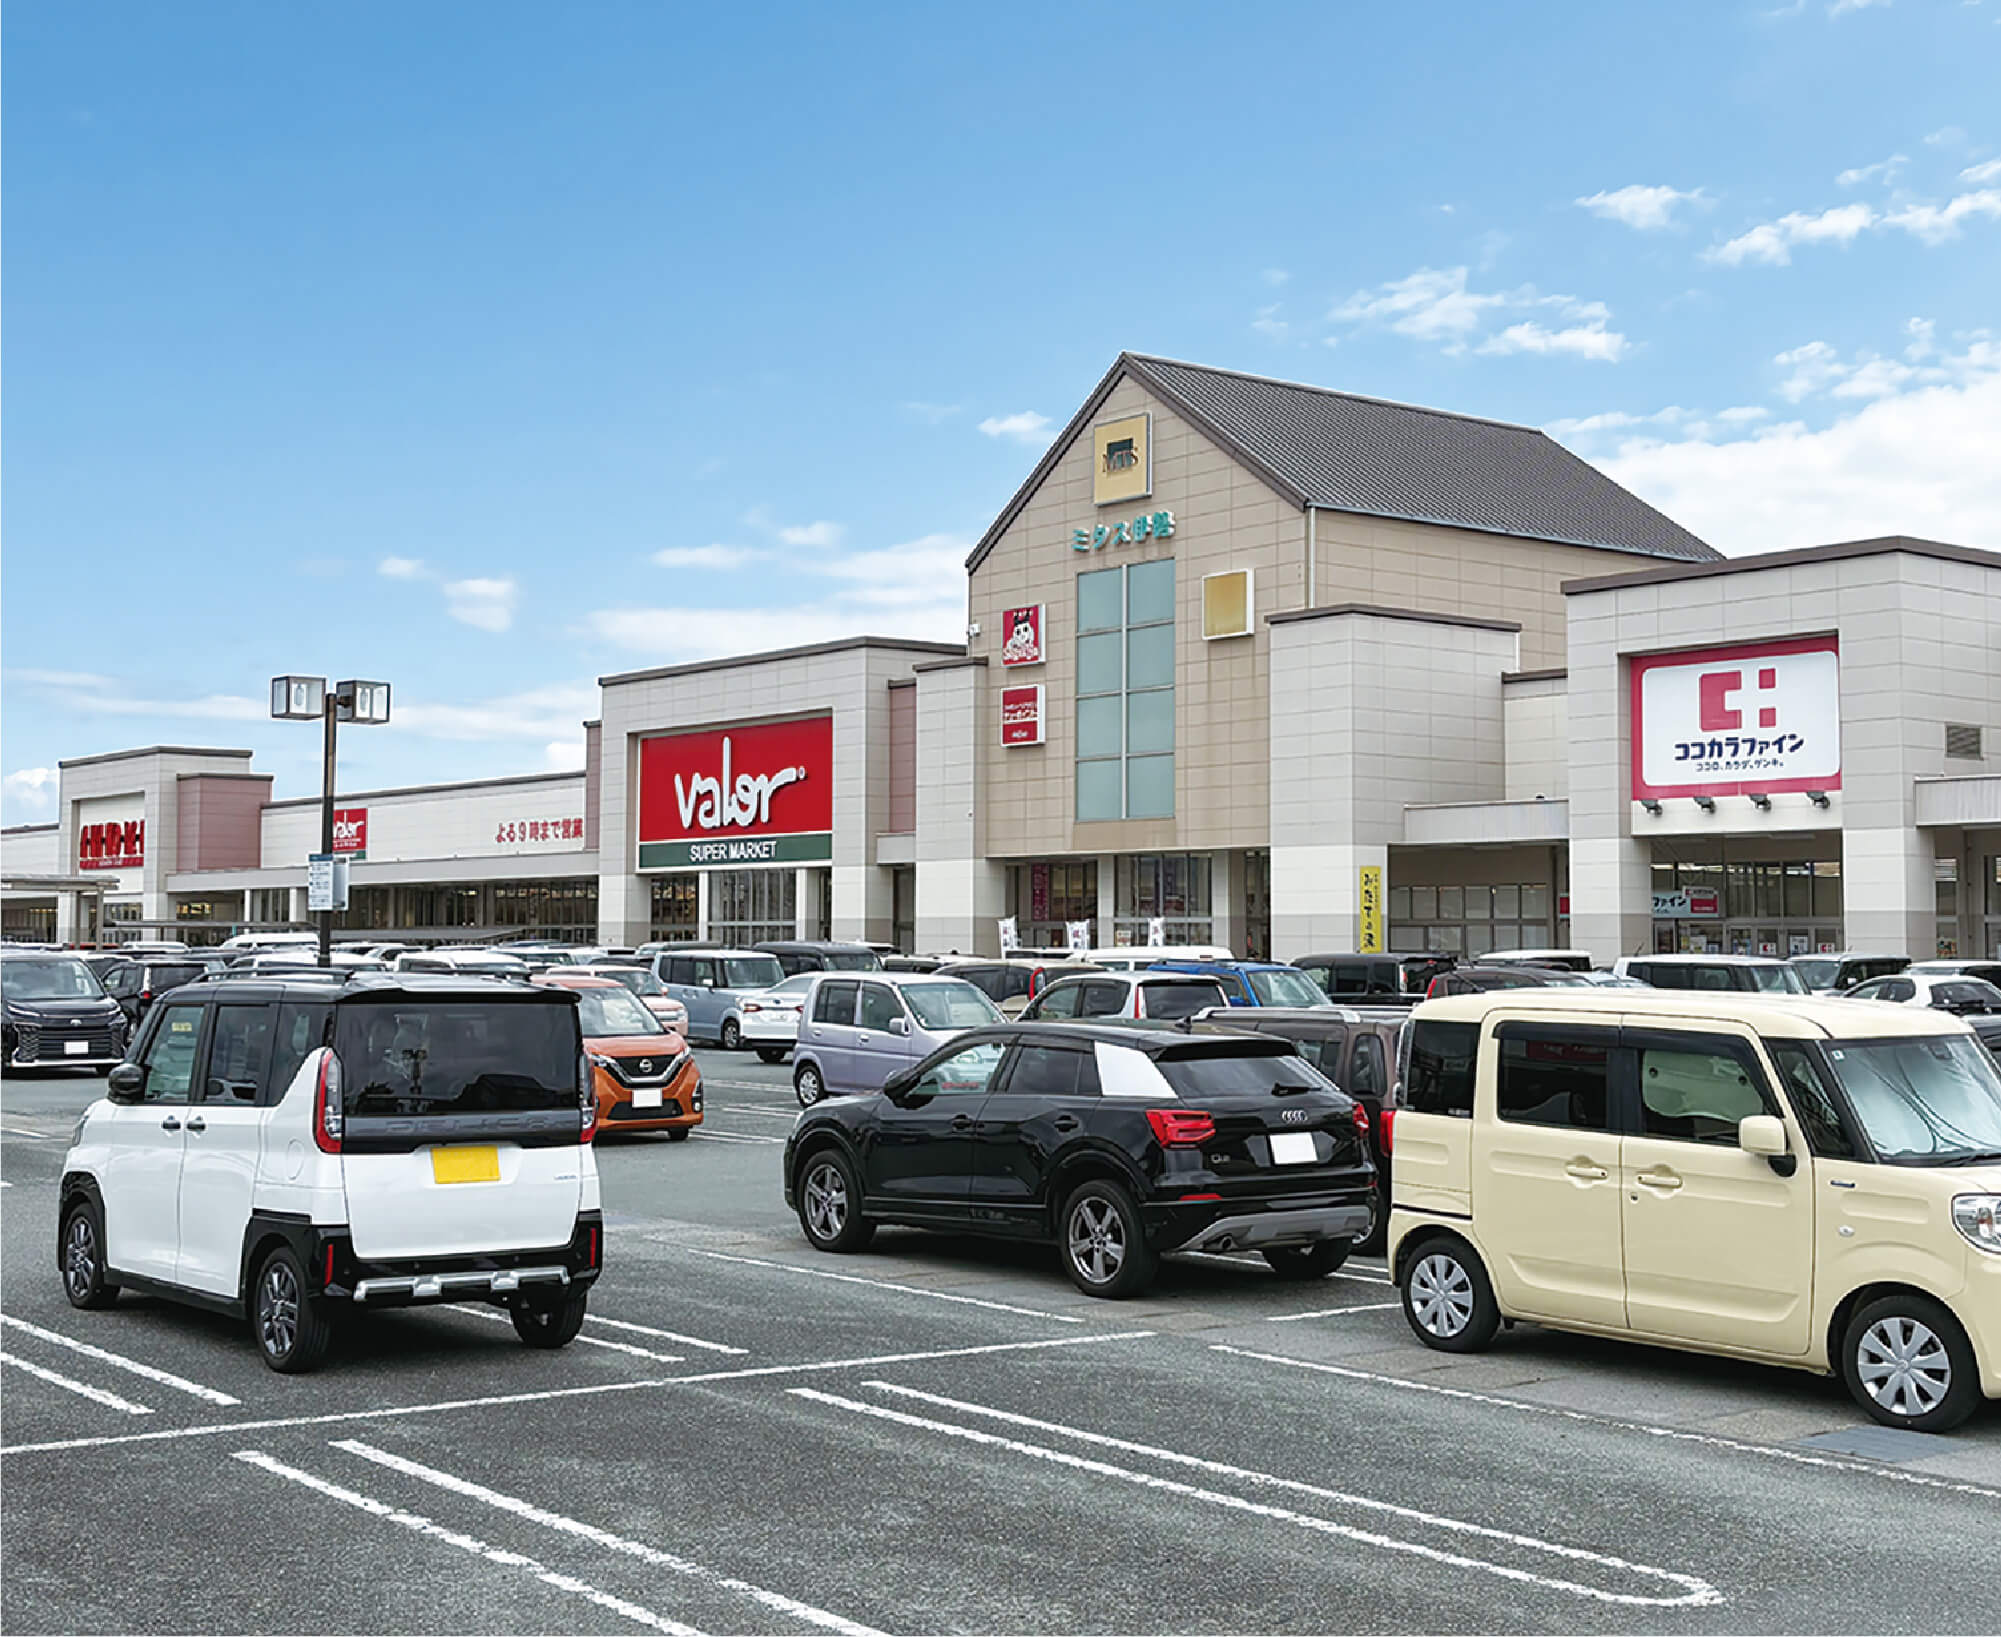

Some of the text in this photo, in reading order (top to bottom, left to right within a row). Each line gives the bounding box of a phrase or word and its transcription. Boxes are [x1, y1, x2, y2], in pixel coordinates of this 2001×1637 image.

[1674, 733, 1805, 761] ココカラファイン
[689, 840, 777, 862] SUPER MARKET
